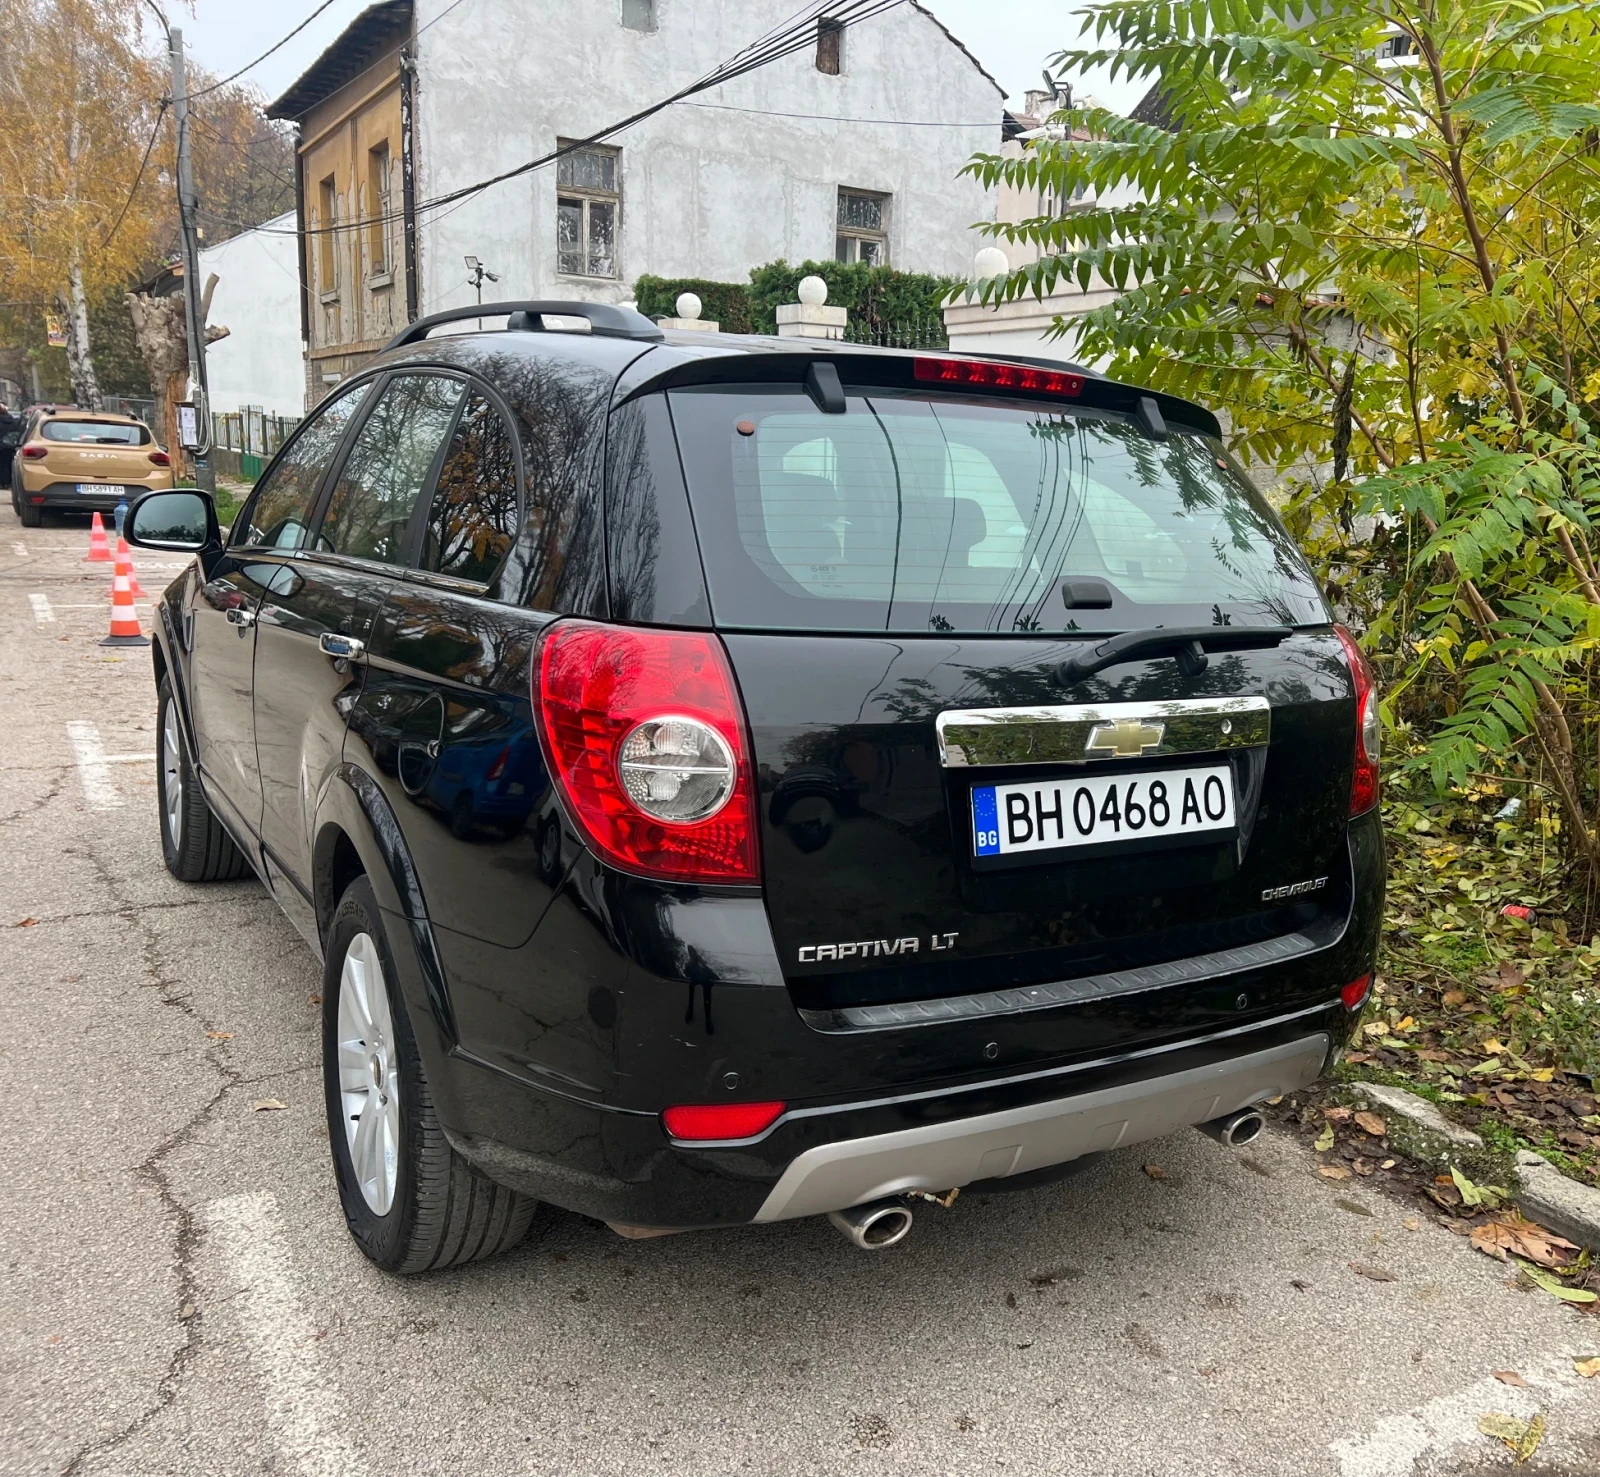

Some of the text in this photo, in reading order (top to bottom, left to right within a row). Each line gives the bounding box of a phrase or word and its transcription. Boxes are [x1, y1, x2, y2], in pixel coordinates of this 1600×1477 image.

[1005, 775, 1226, 844] BH 0468 AO
[978, 830, 998, 847] BG
[1262, 876, 1329, 901] CHEVROLET
[798, 932, 959, 962] CAPTIVA LT
